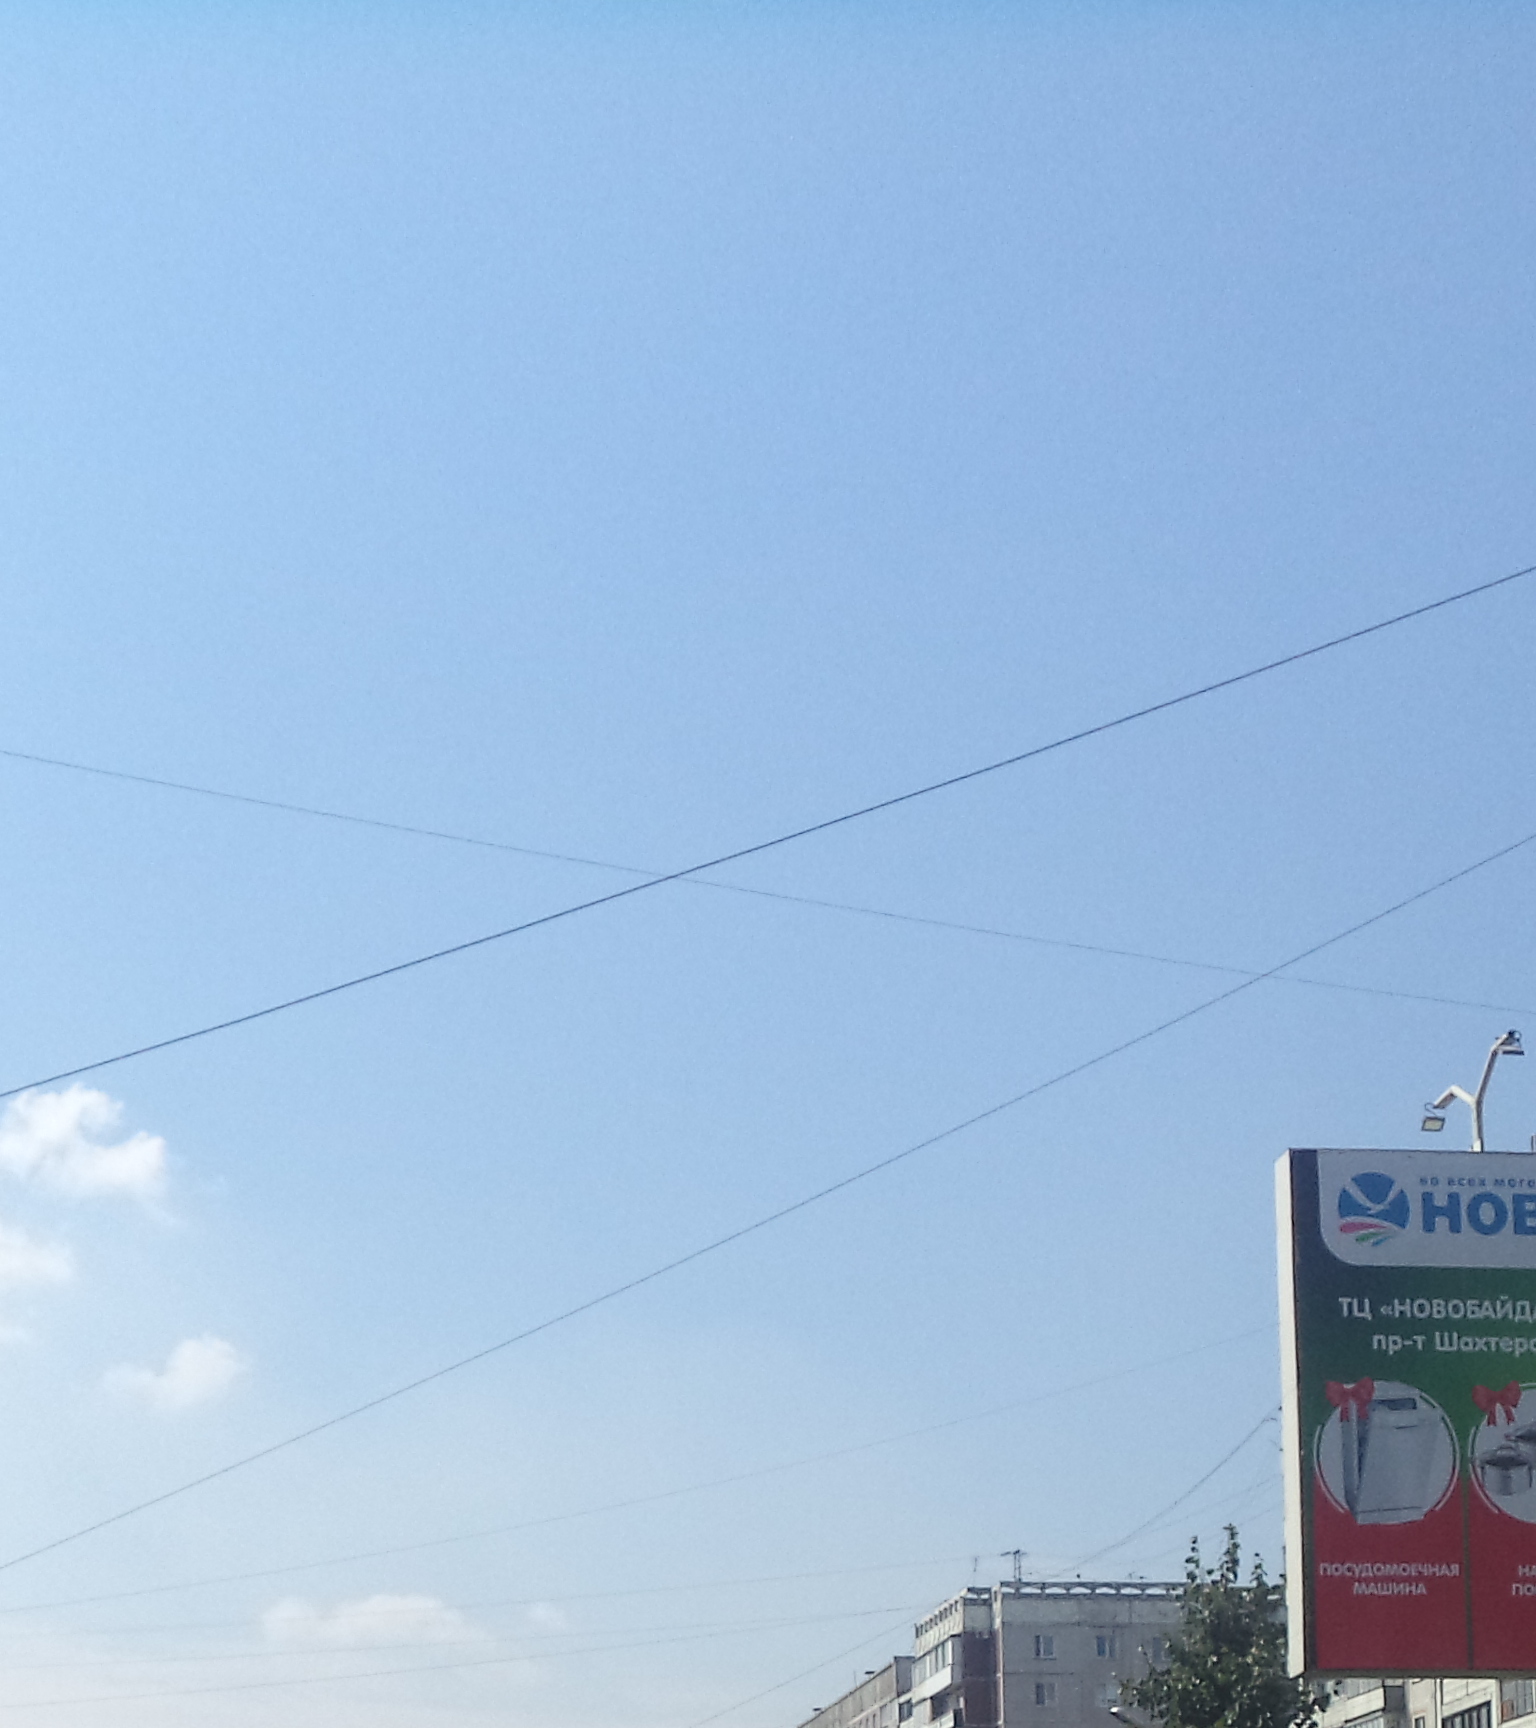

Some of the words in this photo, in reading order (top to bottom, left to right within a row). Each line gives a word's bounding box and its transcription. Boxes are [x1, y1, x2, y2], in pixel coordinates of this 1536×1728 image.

[1447, 1177, 1486, 1187] всех
[1338, 1297, 1372, 1320] ТЦ
[1372, 1334, 1426, 1354] пр-т
[1319, 1562, 1460, 1578] ПОСУДОМОЕЧНАЯ
[1353, 1581, 1427, 1596] МАШИНА
